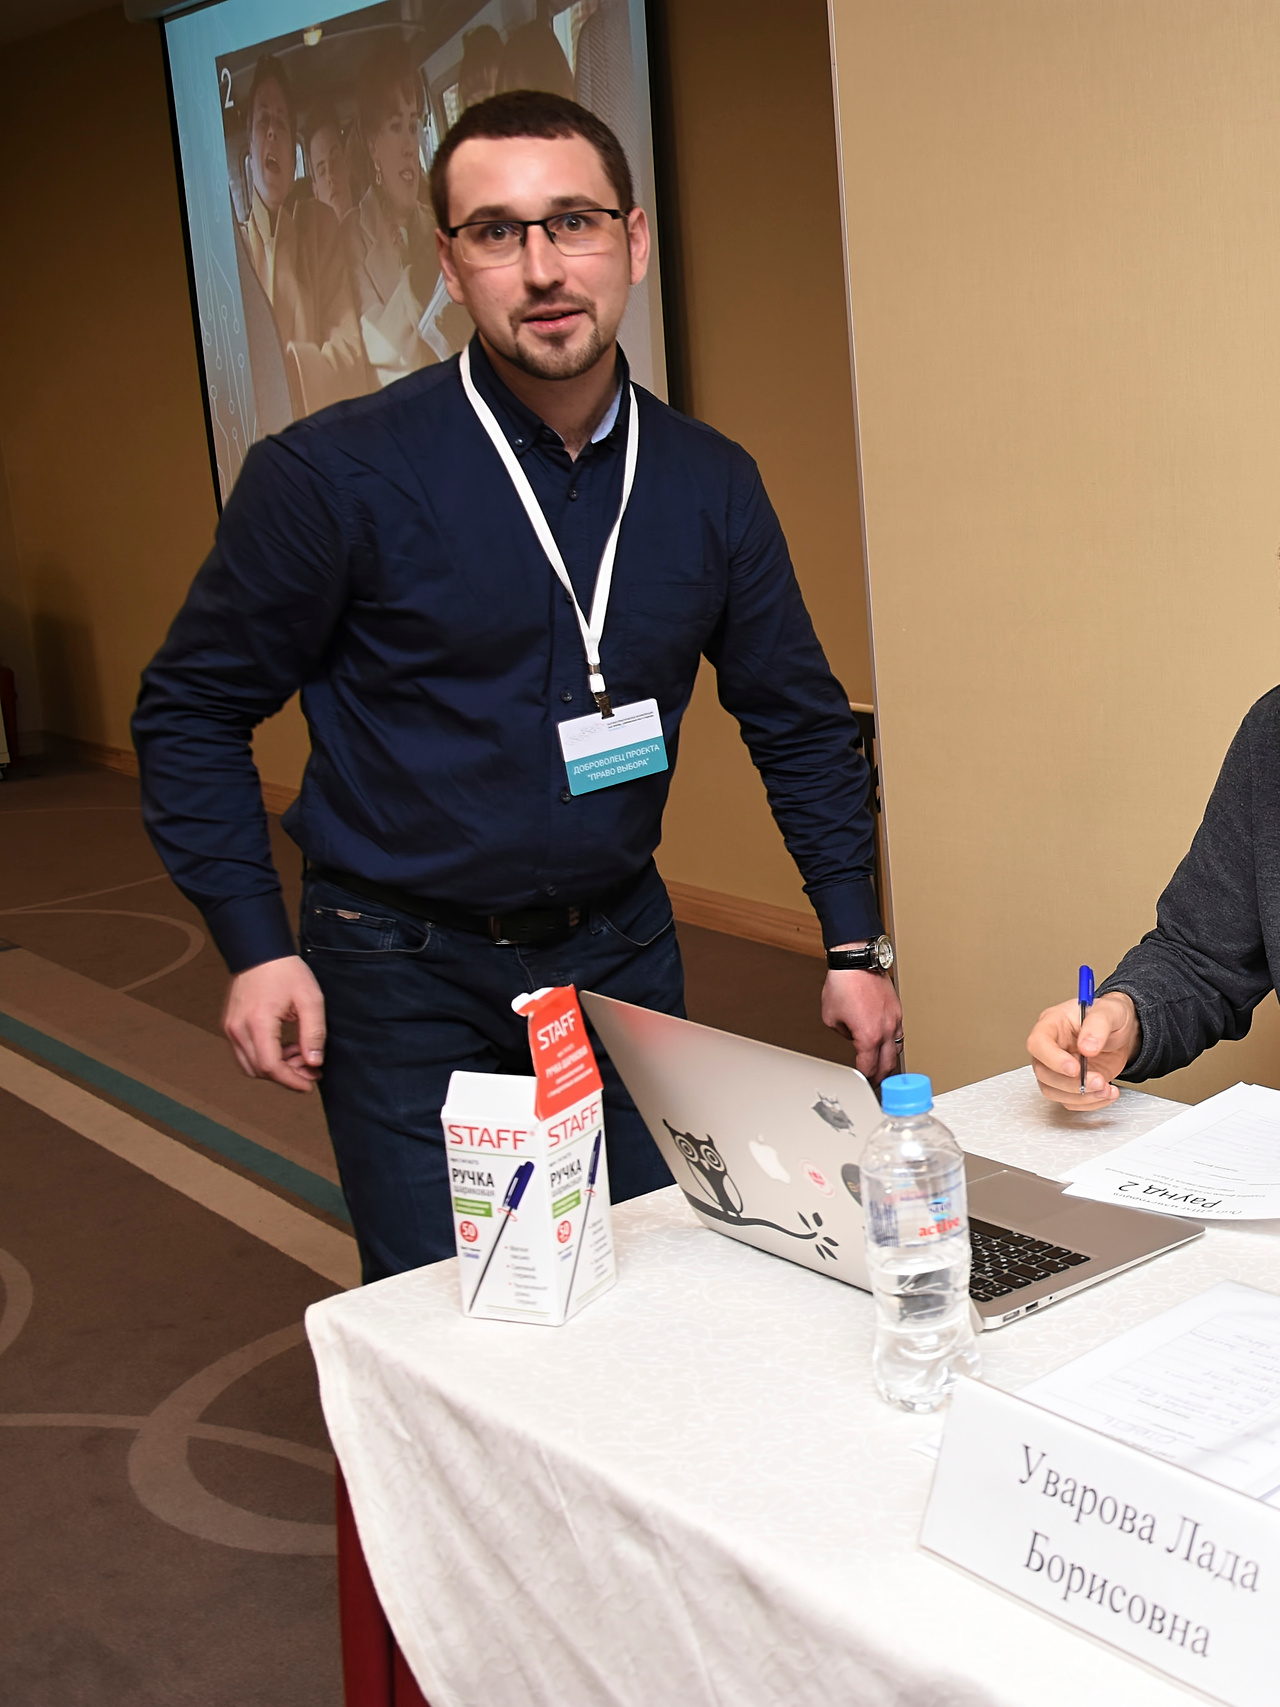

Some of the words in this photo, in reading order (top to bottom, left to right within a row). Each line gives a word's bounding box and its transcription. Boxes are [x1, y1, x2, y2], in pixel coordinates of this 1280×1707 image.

[221, 68, 234, 109] 2
[573, 752, 626, 775] ДОБРОВОЛЕЦ
[626, 744, 660, 760] ПРОЕКТА
[537, 1008, 576, 1050] STAFF
[448, 1124, 527, 1150] STAFF
[547, 1101, 599, 1148] STAFF
[452, 1168, 495, 1188] РУЧКА
[550, 1159, 582, 1188] РУЧКА
[1118, 1181, 1139, 1191] 2
[1142, 1185, 1222, 1209] Раунд
[918, 1217, 960, 1237] active
[1018, 1443, 1156, 1545] Уварова
[1165, 1514, 1260, 1593] Лада
[1022, 1529, 1211, 1658] Борисовна
